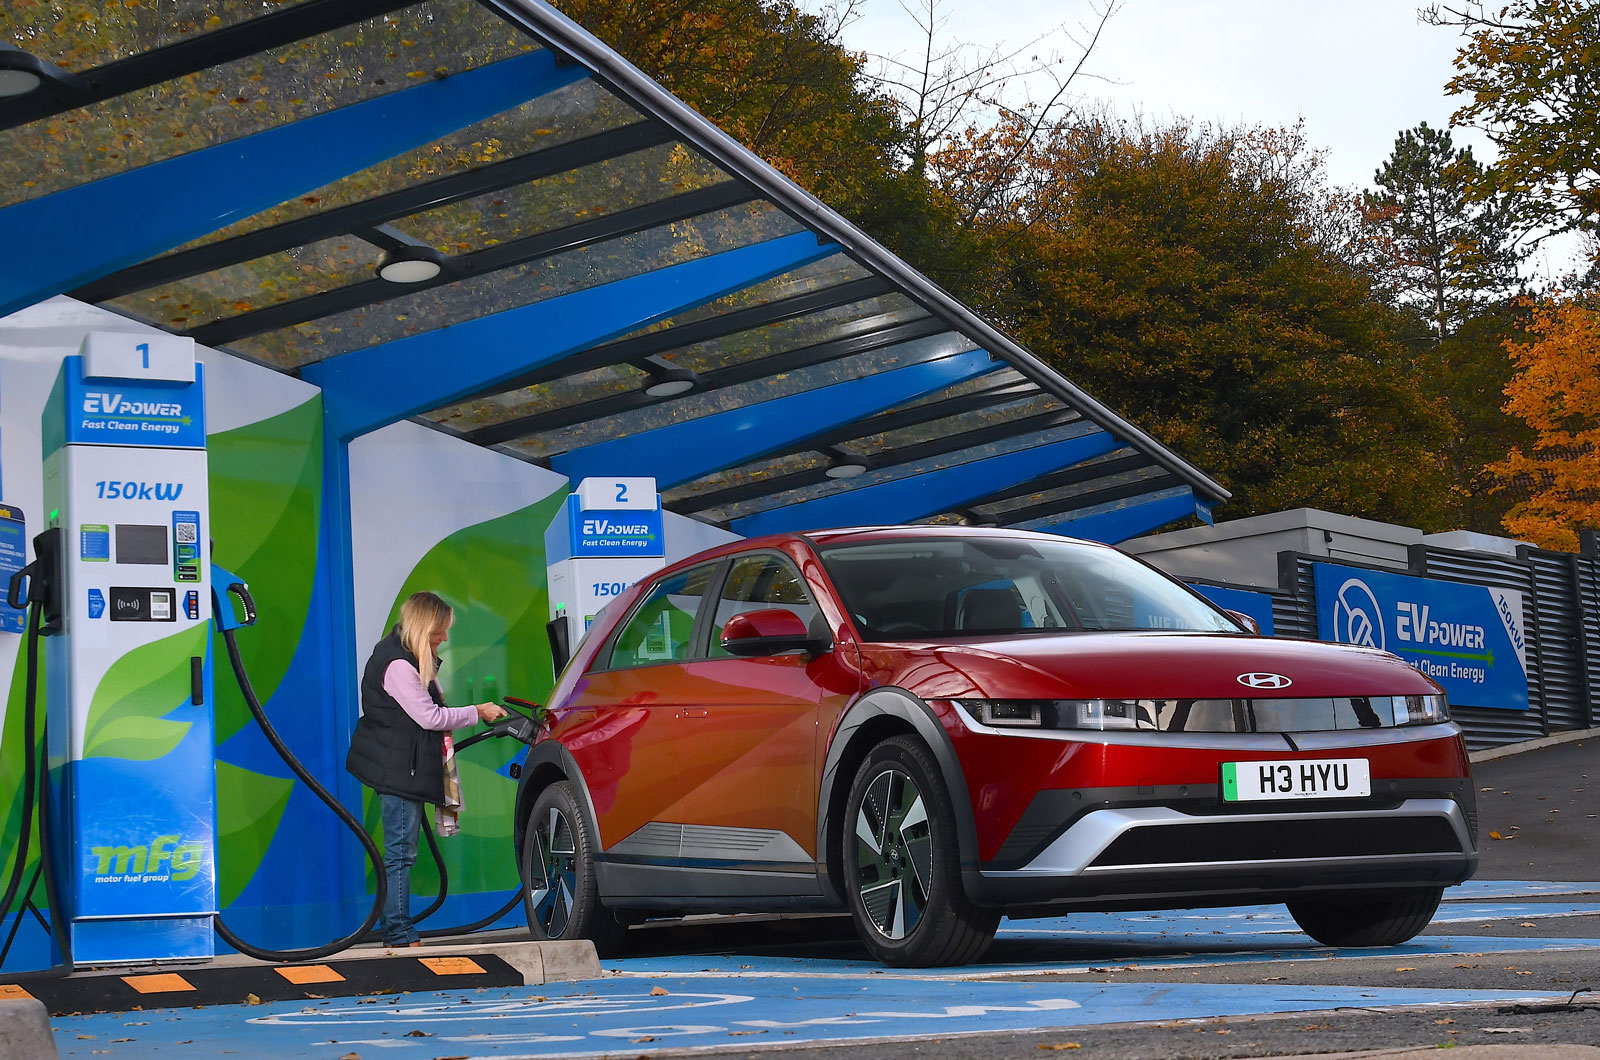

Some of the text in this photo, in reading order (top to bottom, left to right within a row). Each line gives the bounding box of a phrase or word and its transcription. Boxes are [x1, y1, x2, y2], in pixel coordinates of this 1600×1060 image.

[135, 343, 150, 369] 1
[119, 401, 182, 417] POWER
[81, 420, 180, 434] Fast Clean Energy
[95, 481, 183, 501] 150kW
[615, 483, 628, 502] 2
[606, 525, 649, 535] POWER
[582, 539, 648, 547] Fast Clean Energy
[1497, 595, 1524, 650] 150kW
[1428, 621, 1485, 649] POWER
[1420, 659, 1449, 678] Clean
[1450, 662, 1485, 684] Energy
[1259, 763, 1349, 793] H3 HYU
[91, 835, 203, 881] mfg
[143, 875, 169, 883] group
